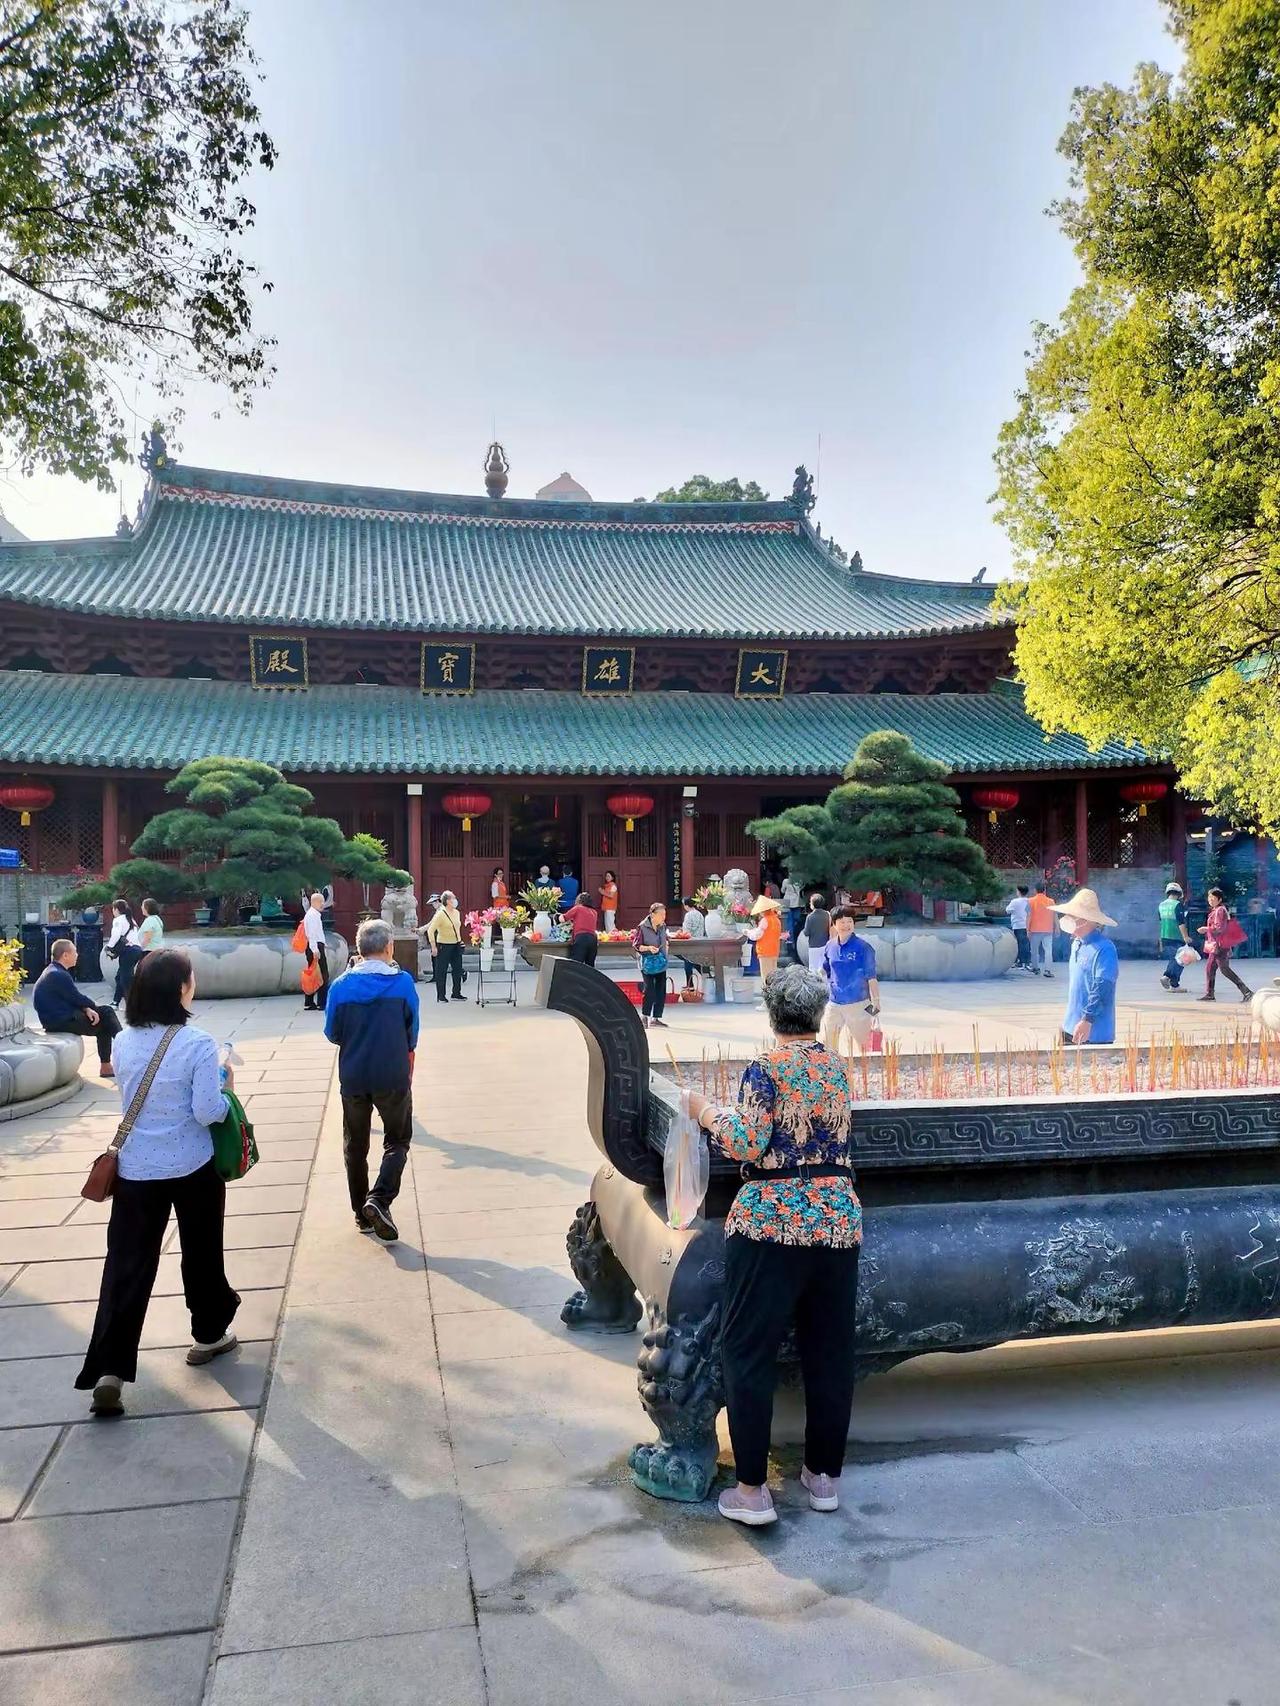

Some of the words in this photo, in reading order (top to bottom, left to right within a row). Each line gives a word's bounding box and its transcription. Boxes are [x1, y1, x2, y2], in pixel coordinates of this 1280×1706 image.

[264, 649, 299, 674] 殿
[438, 652, 459, 684] 寶
[593, 657, 621, 684] 雄
[749, 662, 775, 685] 大
